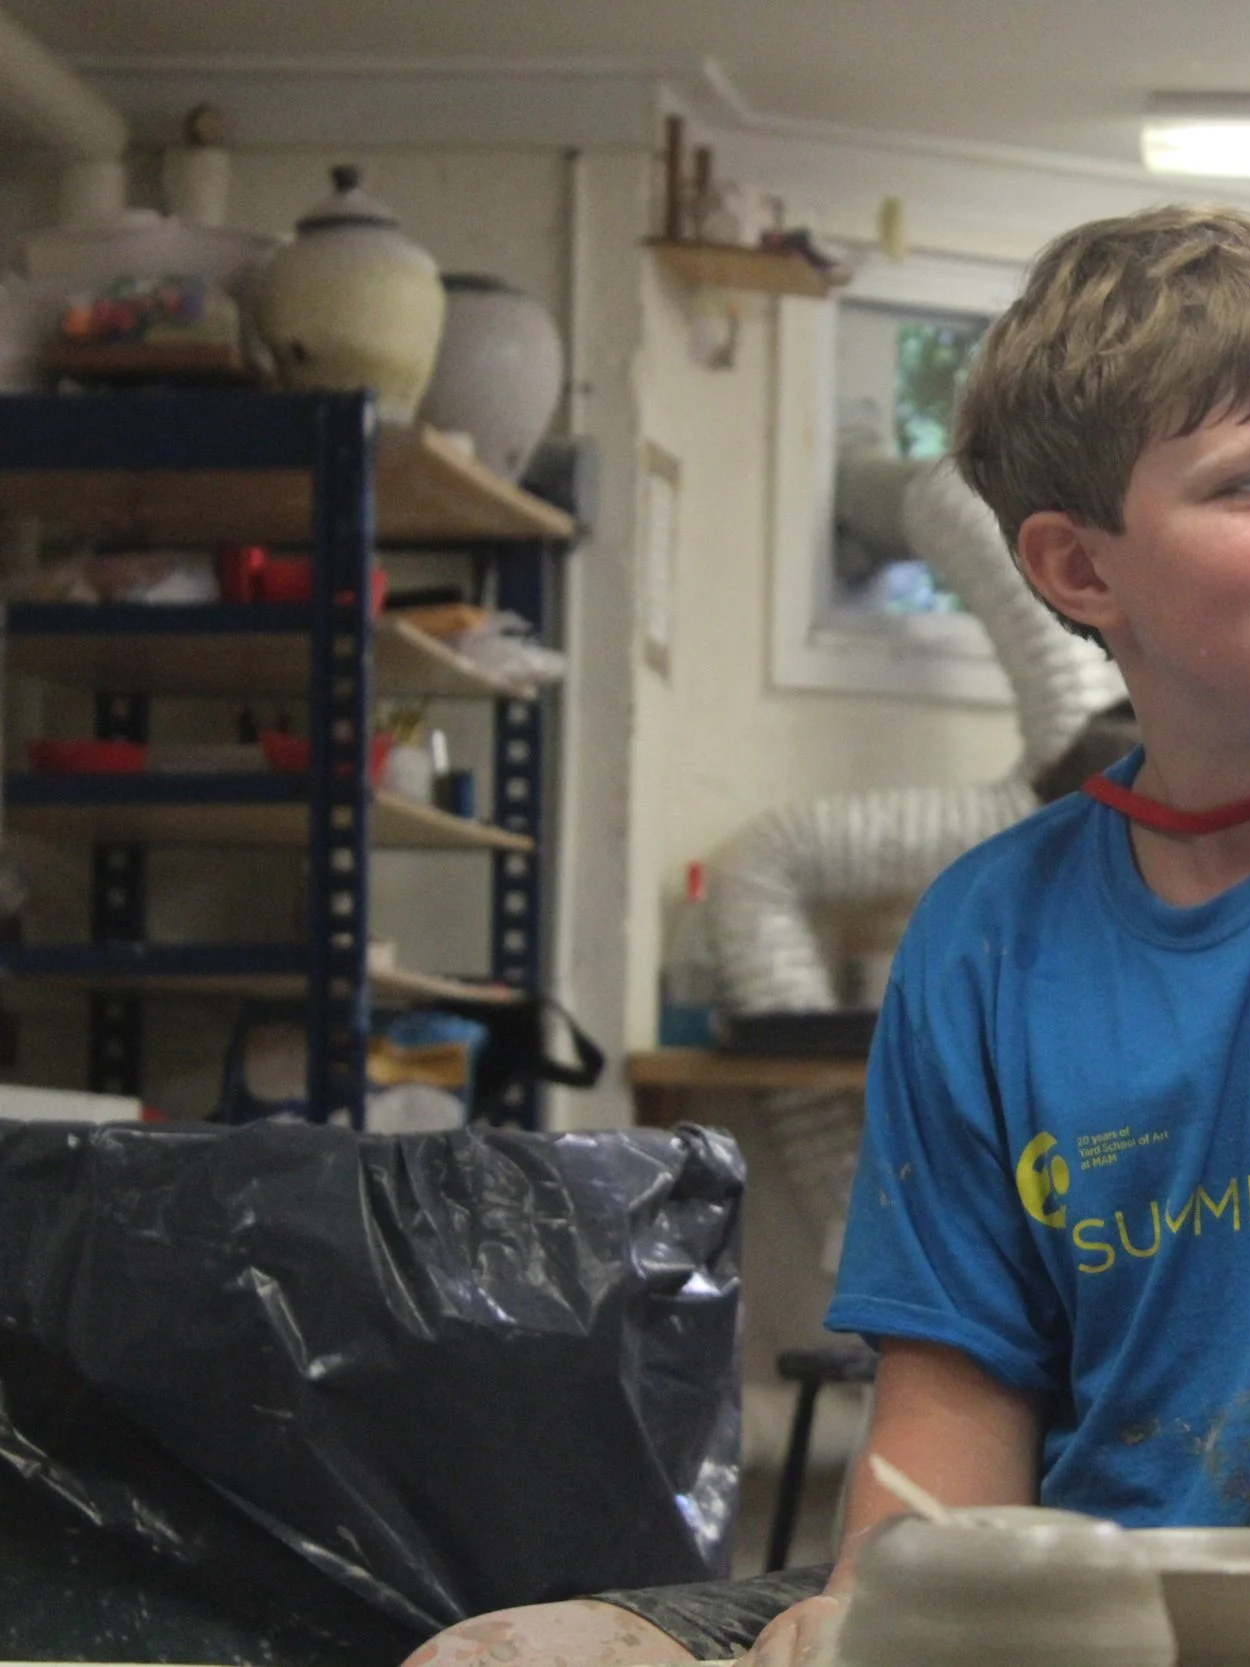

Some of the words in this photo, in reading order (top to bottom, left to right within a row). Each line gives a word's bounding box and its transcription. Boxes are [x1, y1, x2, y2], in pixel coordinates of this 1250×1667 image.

[1077, 1135, 1089, 1147] 20
[1092, 1130, 1117, 1146] years
[1119, 1125, 1130, 1138] of
[1102, 1137, 1137, 1152] School
[1138, 1133, 1149, 1145] of
[1152, 1130, 1169, 1143] Art
[1081, 1160, 1090, 1171] at
[1092, 1154, 1117, 1168] MAM
